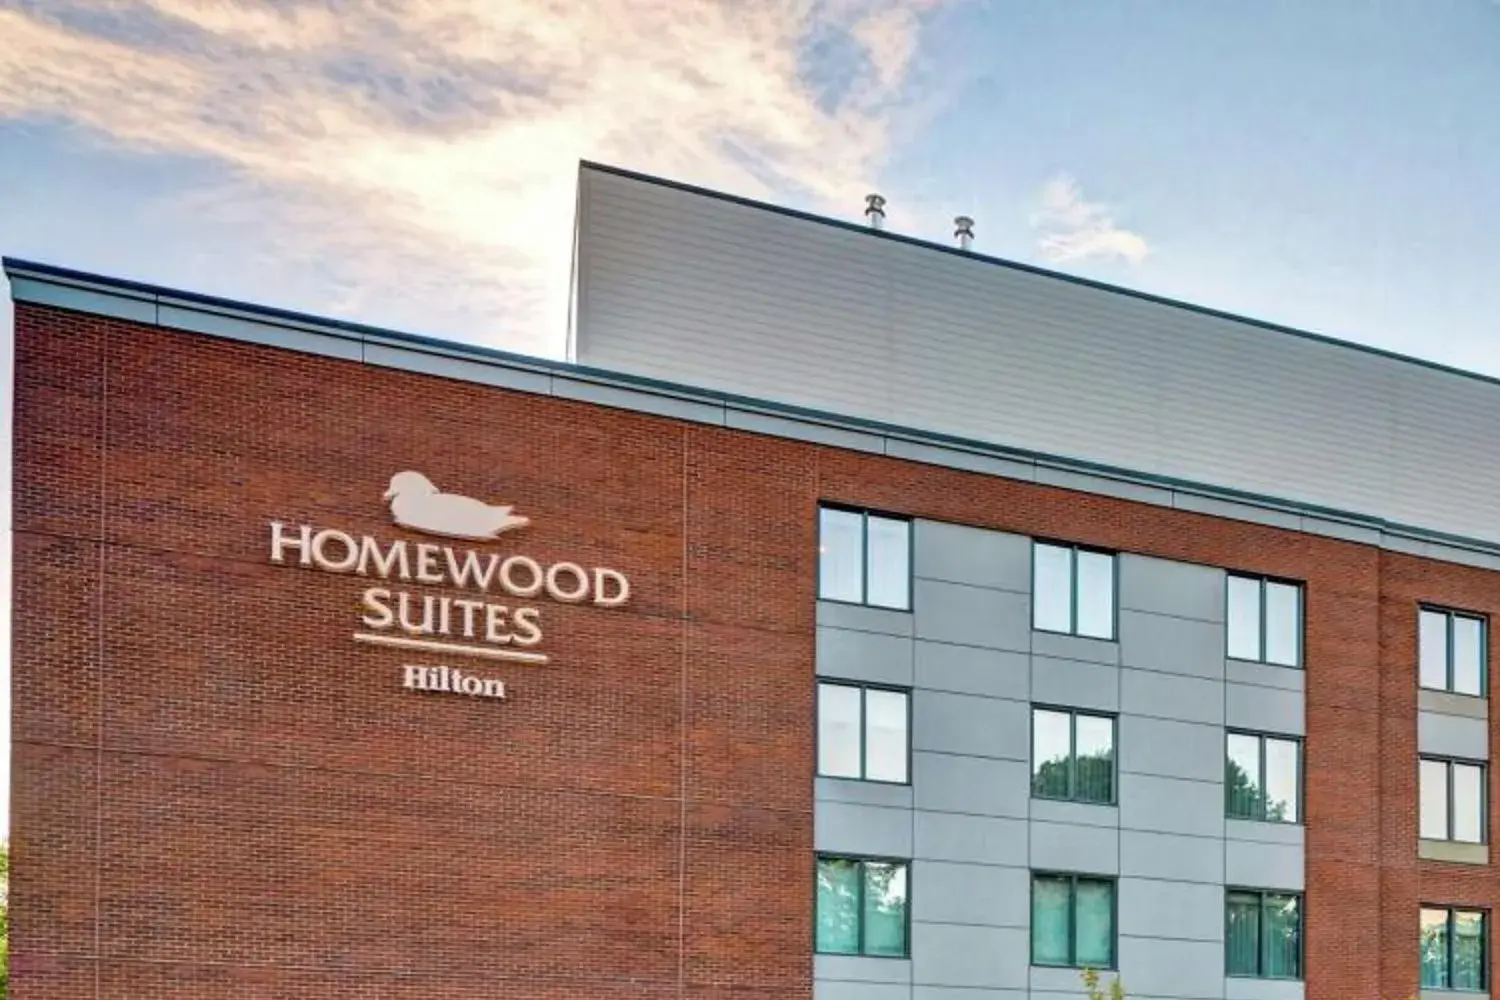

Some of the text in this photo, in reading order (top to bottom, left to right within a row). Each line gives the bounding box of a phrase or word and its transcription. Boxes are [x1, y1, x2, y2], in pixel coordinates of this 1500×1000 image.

[270, 521, 630, 607] HOMEWOOD
[361, 587, 543, 646] SUITES
[403, 665, 506, 699] Hilton
